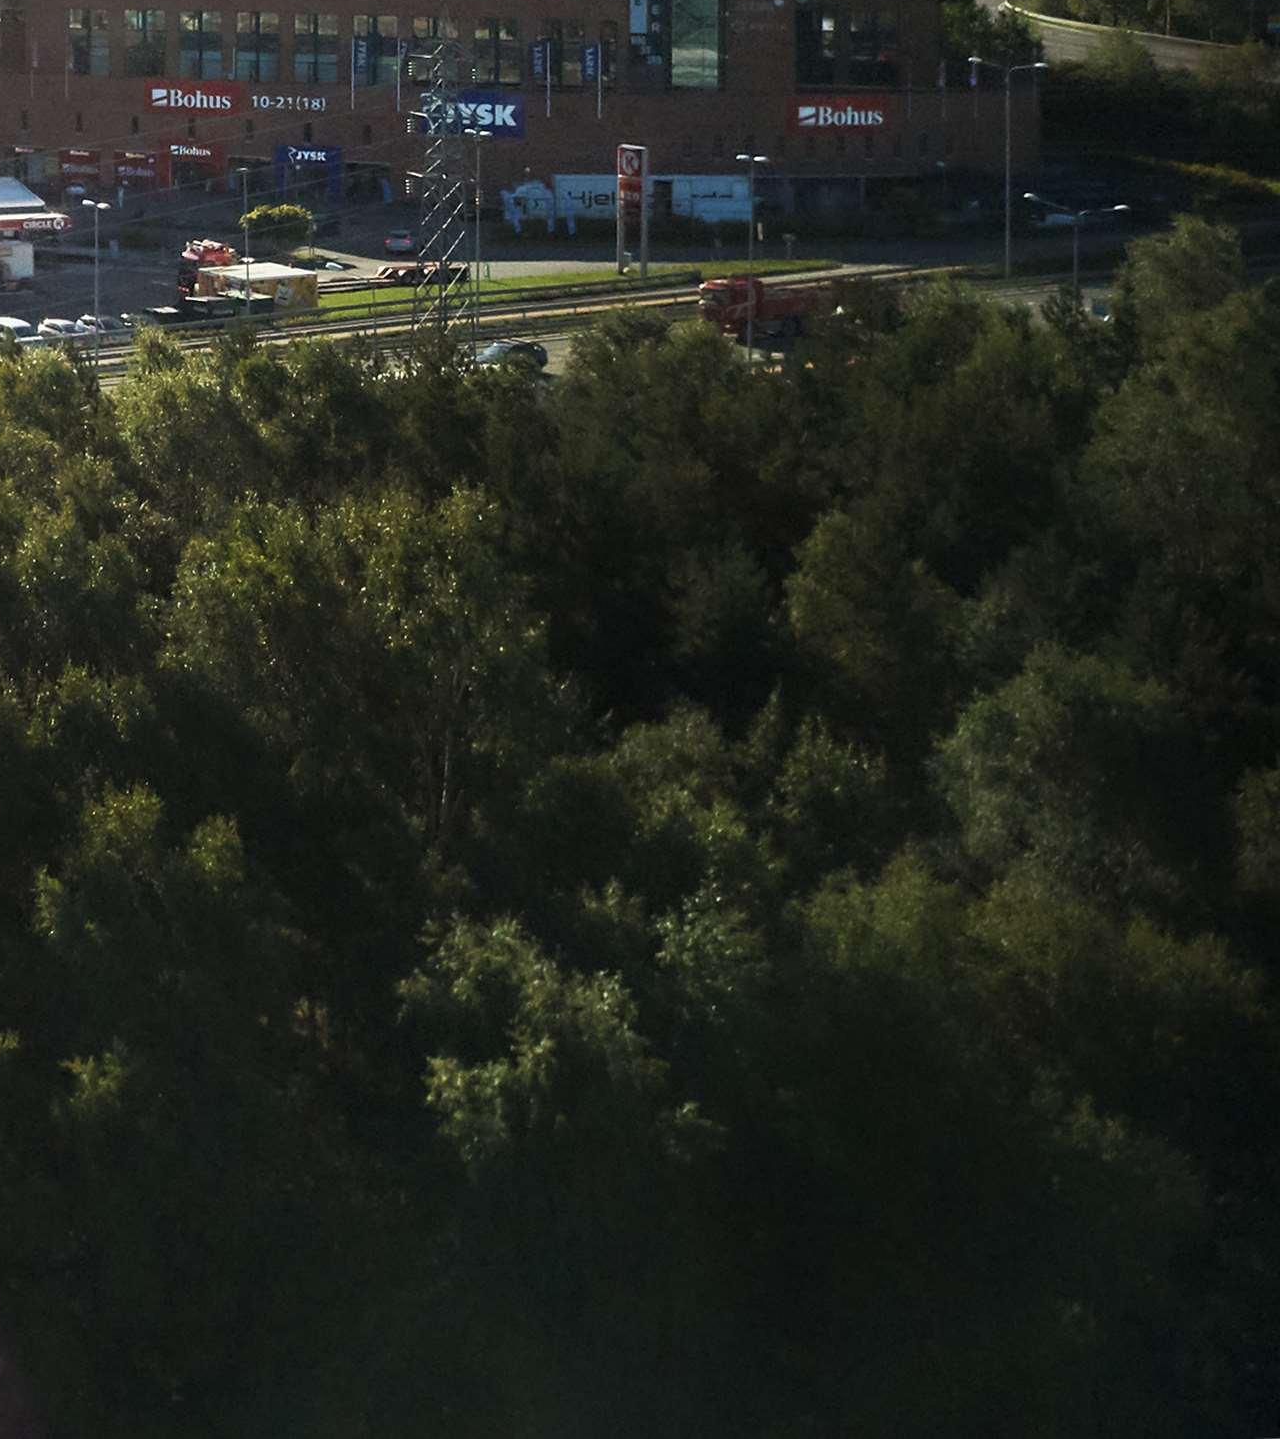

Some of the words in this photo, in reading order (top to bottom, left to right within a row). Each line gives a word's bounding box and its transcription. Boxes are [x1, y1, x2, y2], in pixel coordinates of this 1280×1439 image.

[169, 88, 232, 110] Bohus
[817, 105, 885, 126] Bohus
[295, 150, 327, 161] JYSK
[23, 220, 53, 230] CIRCLE
